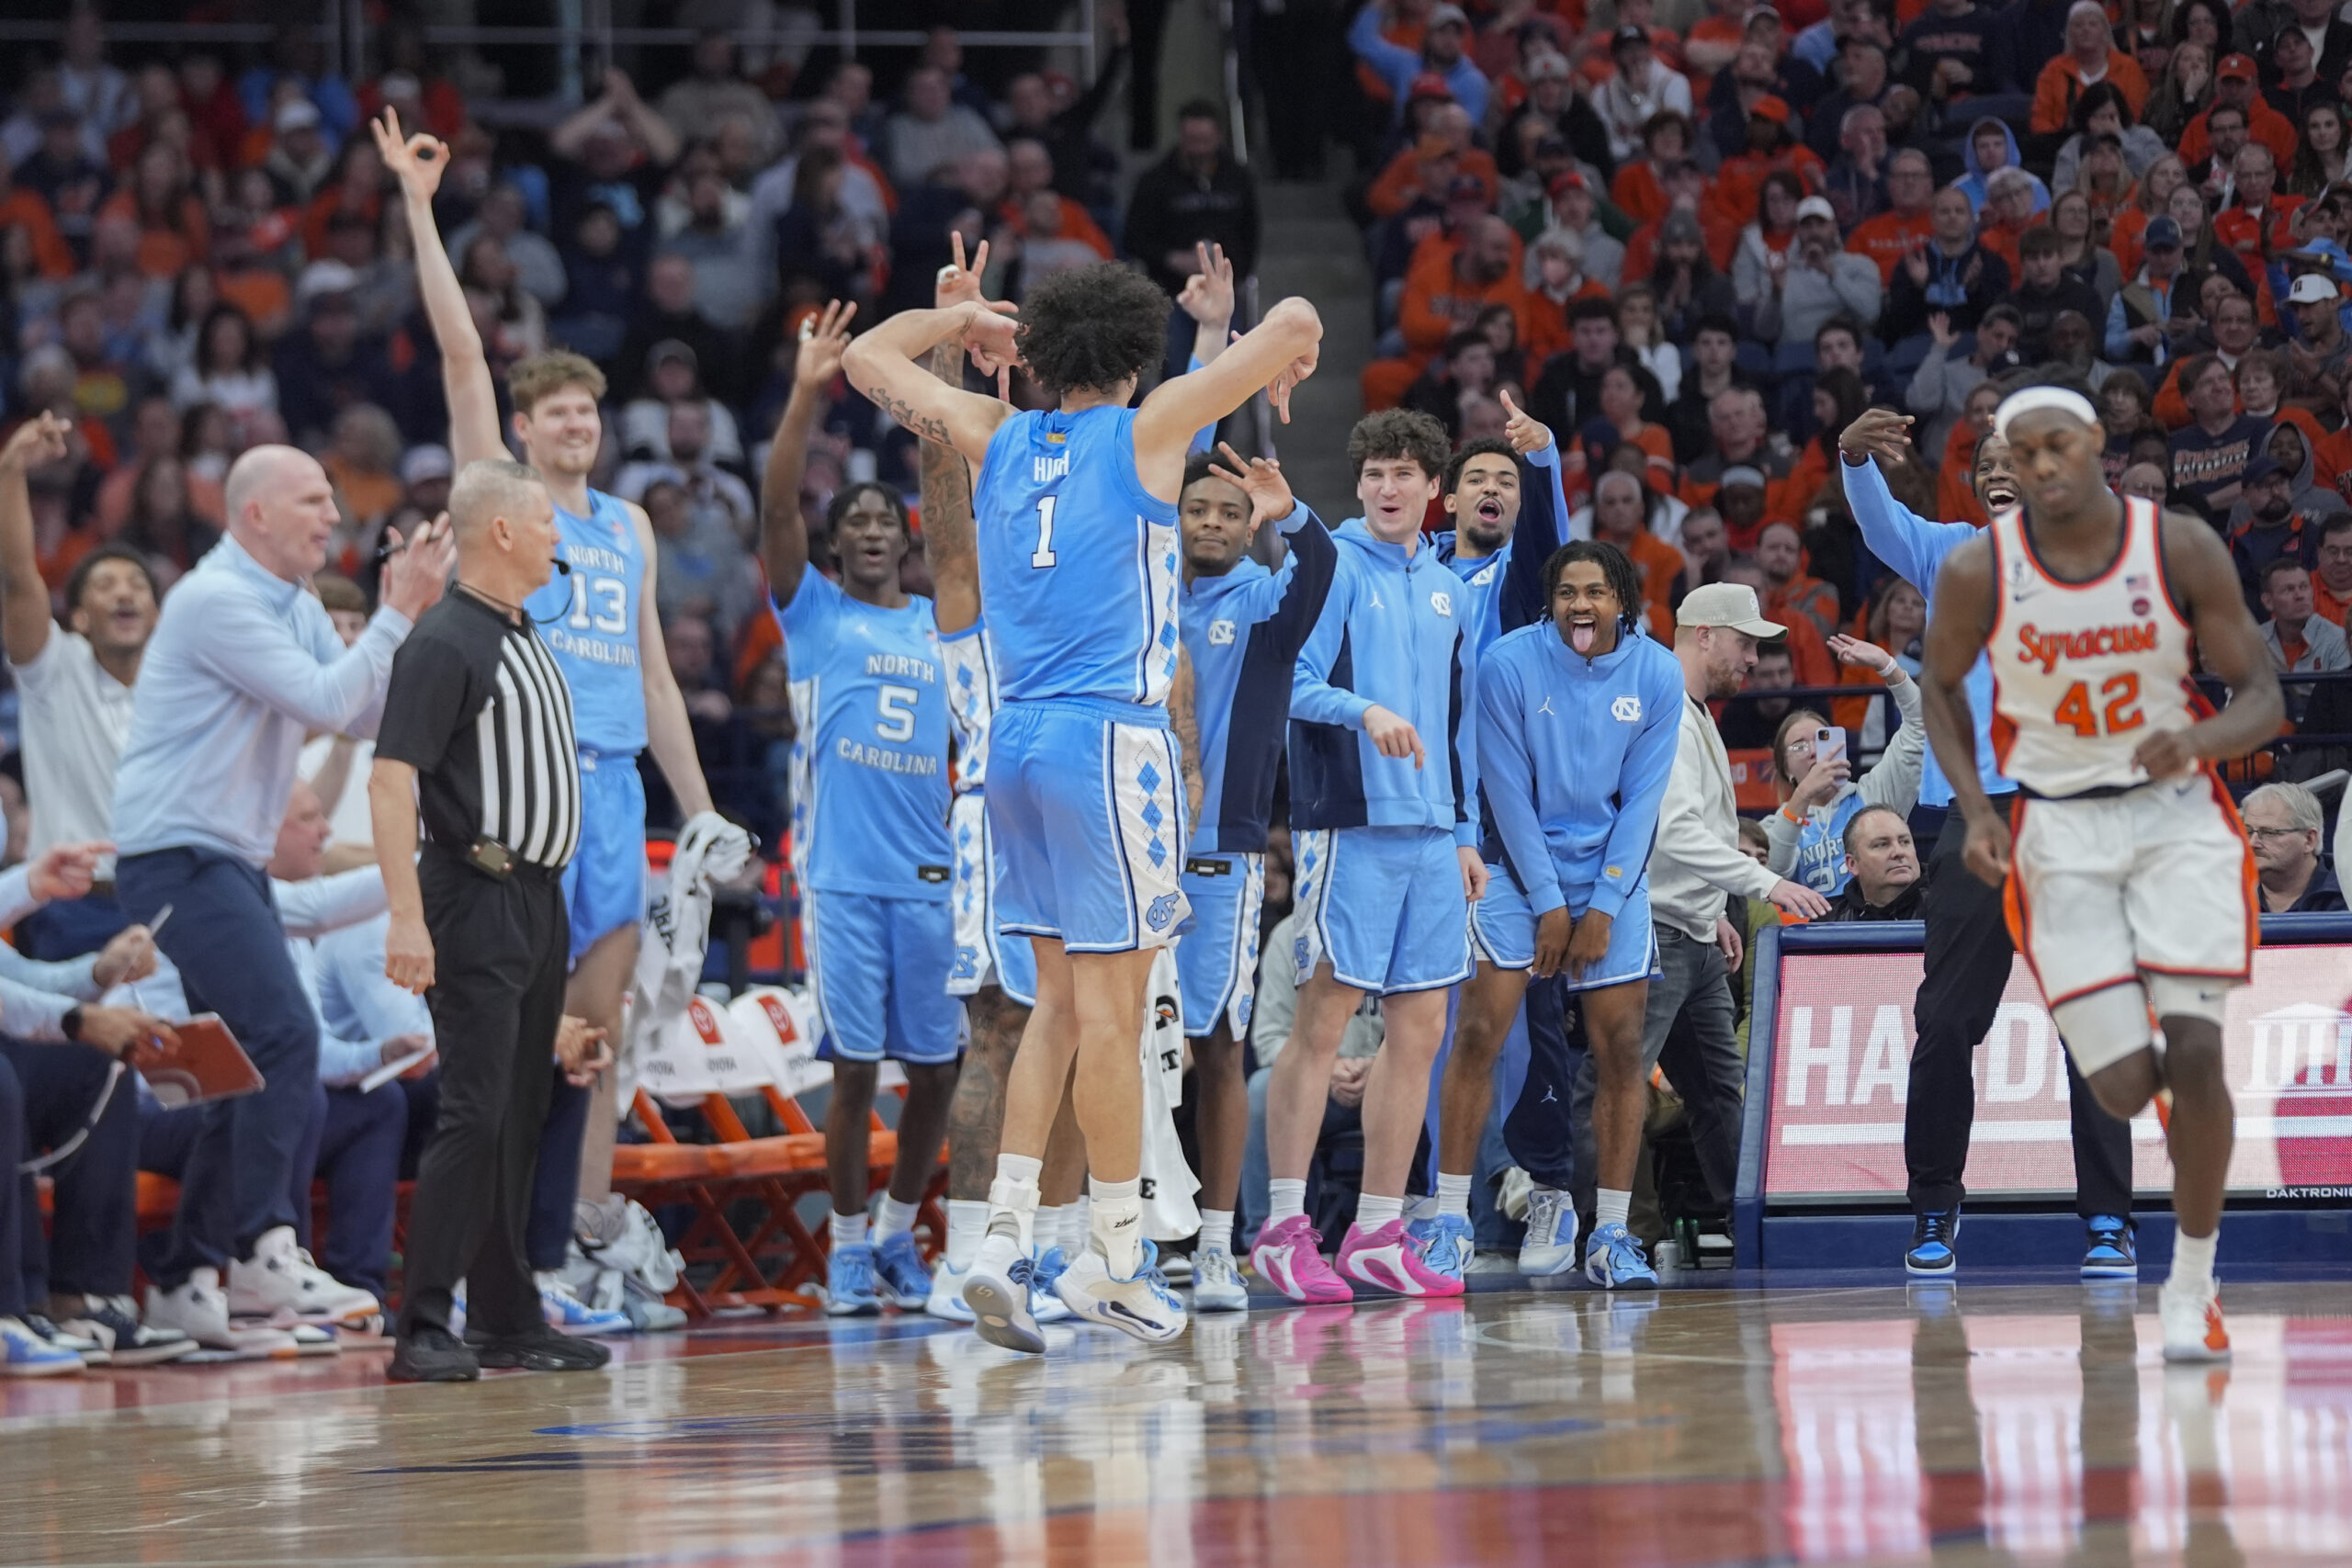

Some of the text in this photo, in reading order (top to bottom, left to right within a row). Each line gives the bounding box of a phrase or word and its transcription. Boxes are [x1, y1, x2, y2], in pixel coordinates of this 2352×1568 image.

[1032, 495, 1057, 570] 1
[567, 545, 625, 575] NORTH
[569, 570, 628, 636] 13
[550, 627, 636, 666] CAROLINA
[866, 653, 935, 683] NORTH
[2018, 621, 2157, 675] Syracuse
[876, 683, 919, 744] 5
[2054, 671, 2145, 738] 42
[837, 737, 938, 775] CAROLINA
[2267, 1187, 2352, 1199] DAKTRONI
